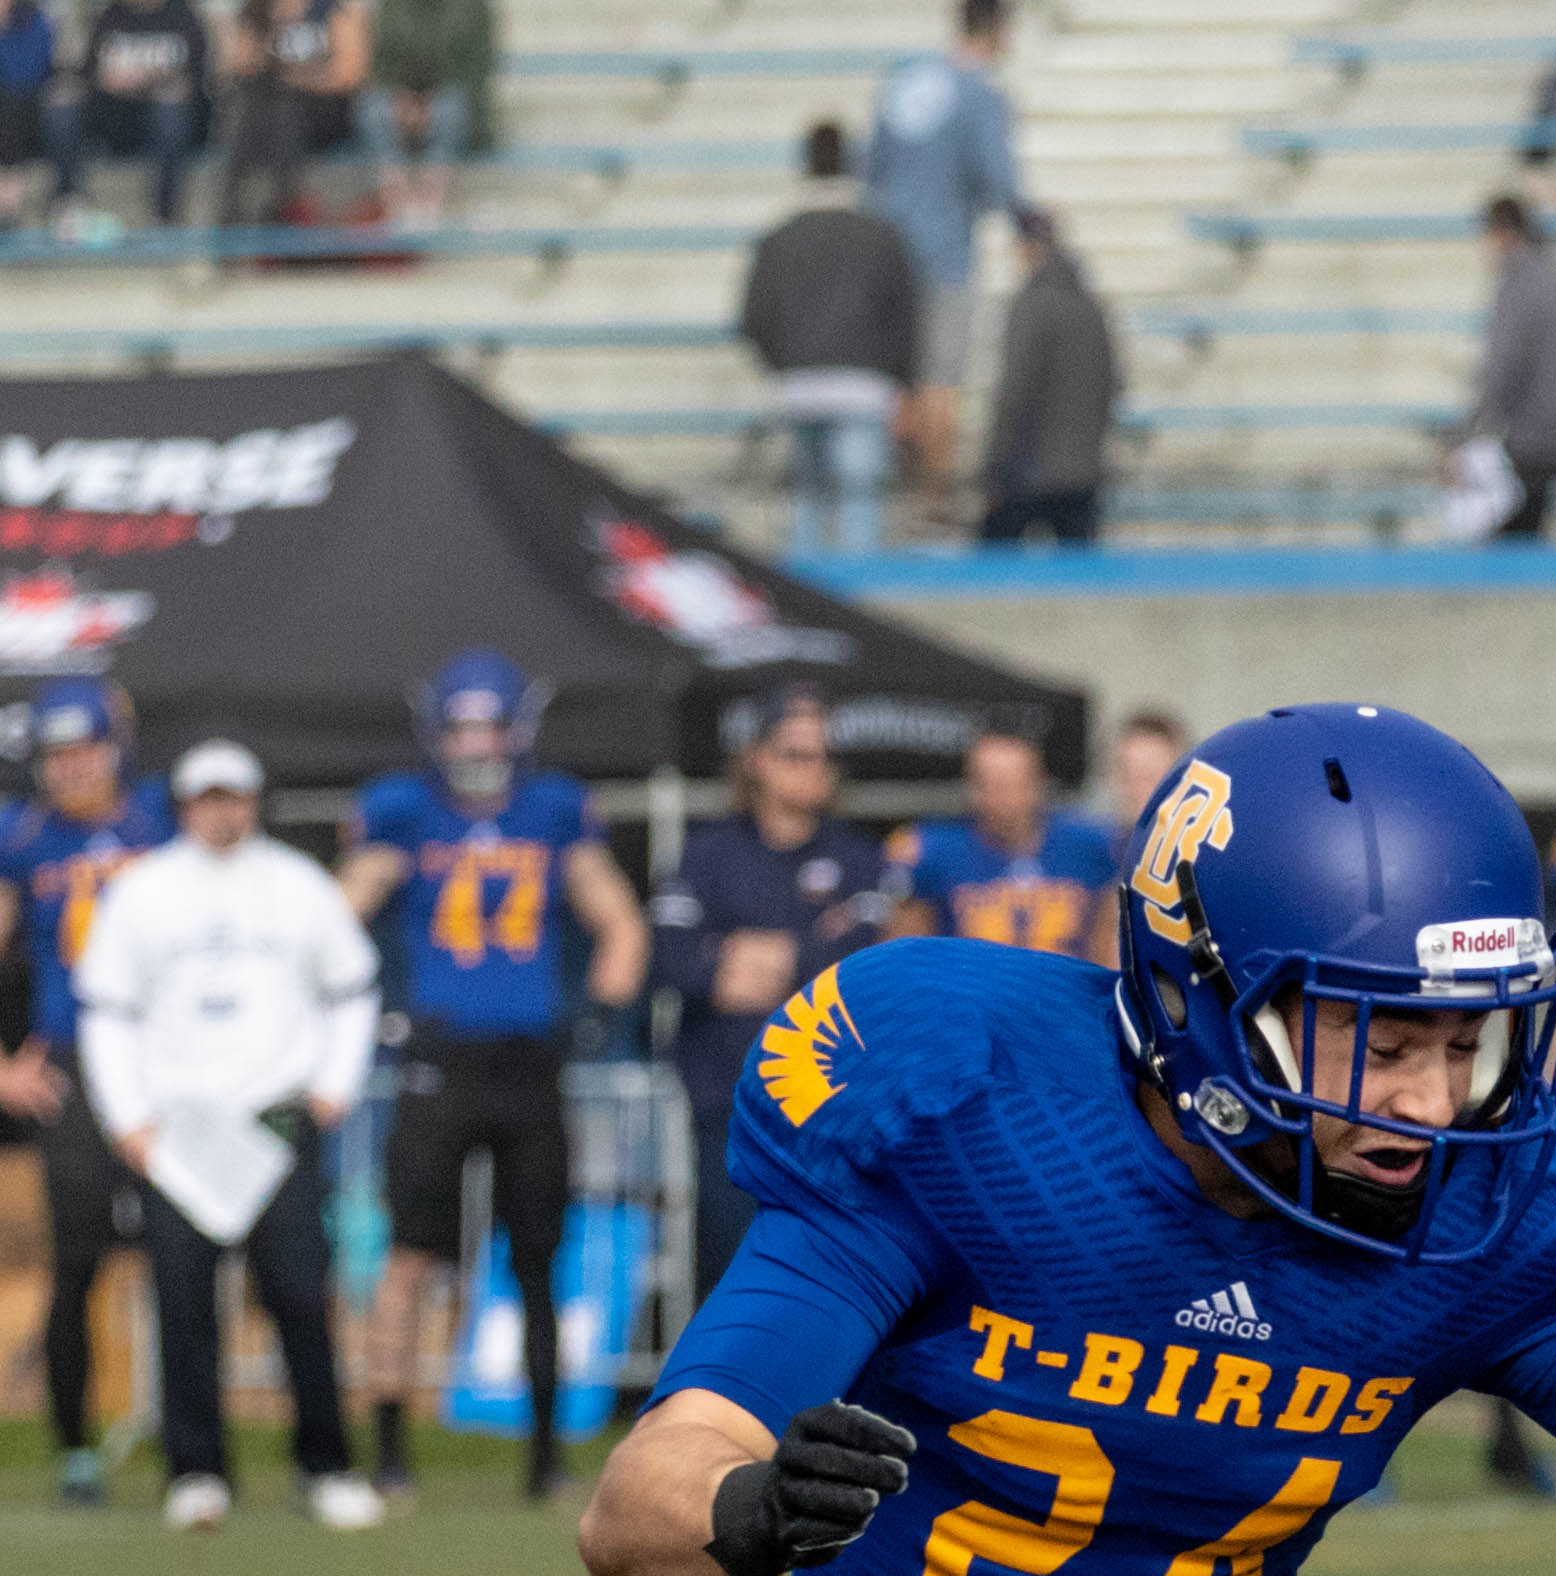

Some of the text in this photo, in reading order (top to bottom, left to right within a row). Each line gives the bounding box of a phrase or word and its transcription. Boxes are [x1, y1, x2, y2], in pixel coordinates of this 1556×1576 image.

[1452, 925, 1515, 952] Riddell
[1175, 1304, 1273, 1341] adidas
[968, 1305, 1415, 1435] T-BIRDS
